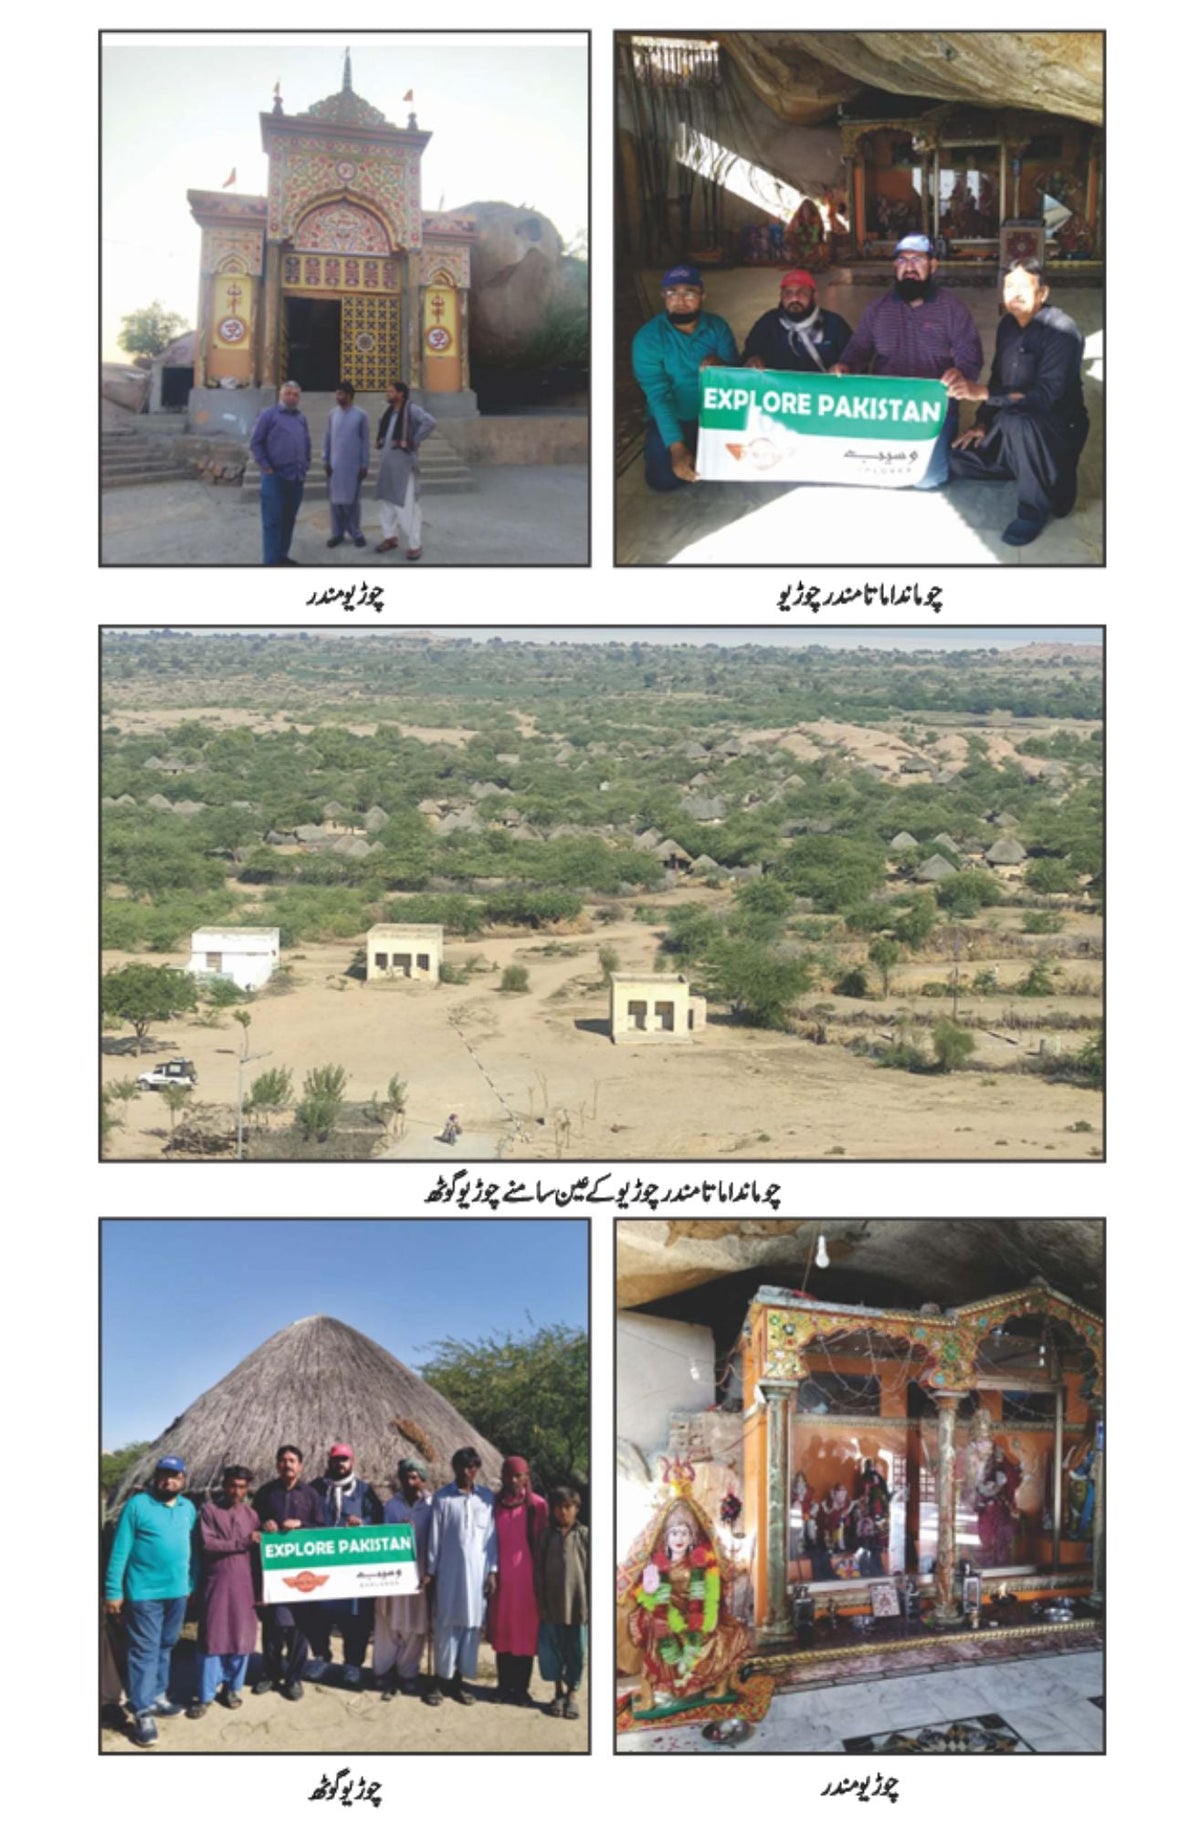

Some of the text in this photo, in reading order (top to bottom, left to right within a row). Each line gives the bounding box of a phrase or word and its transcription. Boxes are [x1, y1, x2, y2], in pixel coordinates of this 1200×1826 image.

[703, 387, 941, 423] EXPLORE PAKISTAN
[265, 1535, 412, 1558] EXPLORE PAKISTAN
